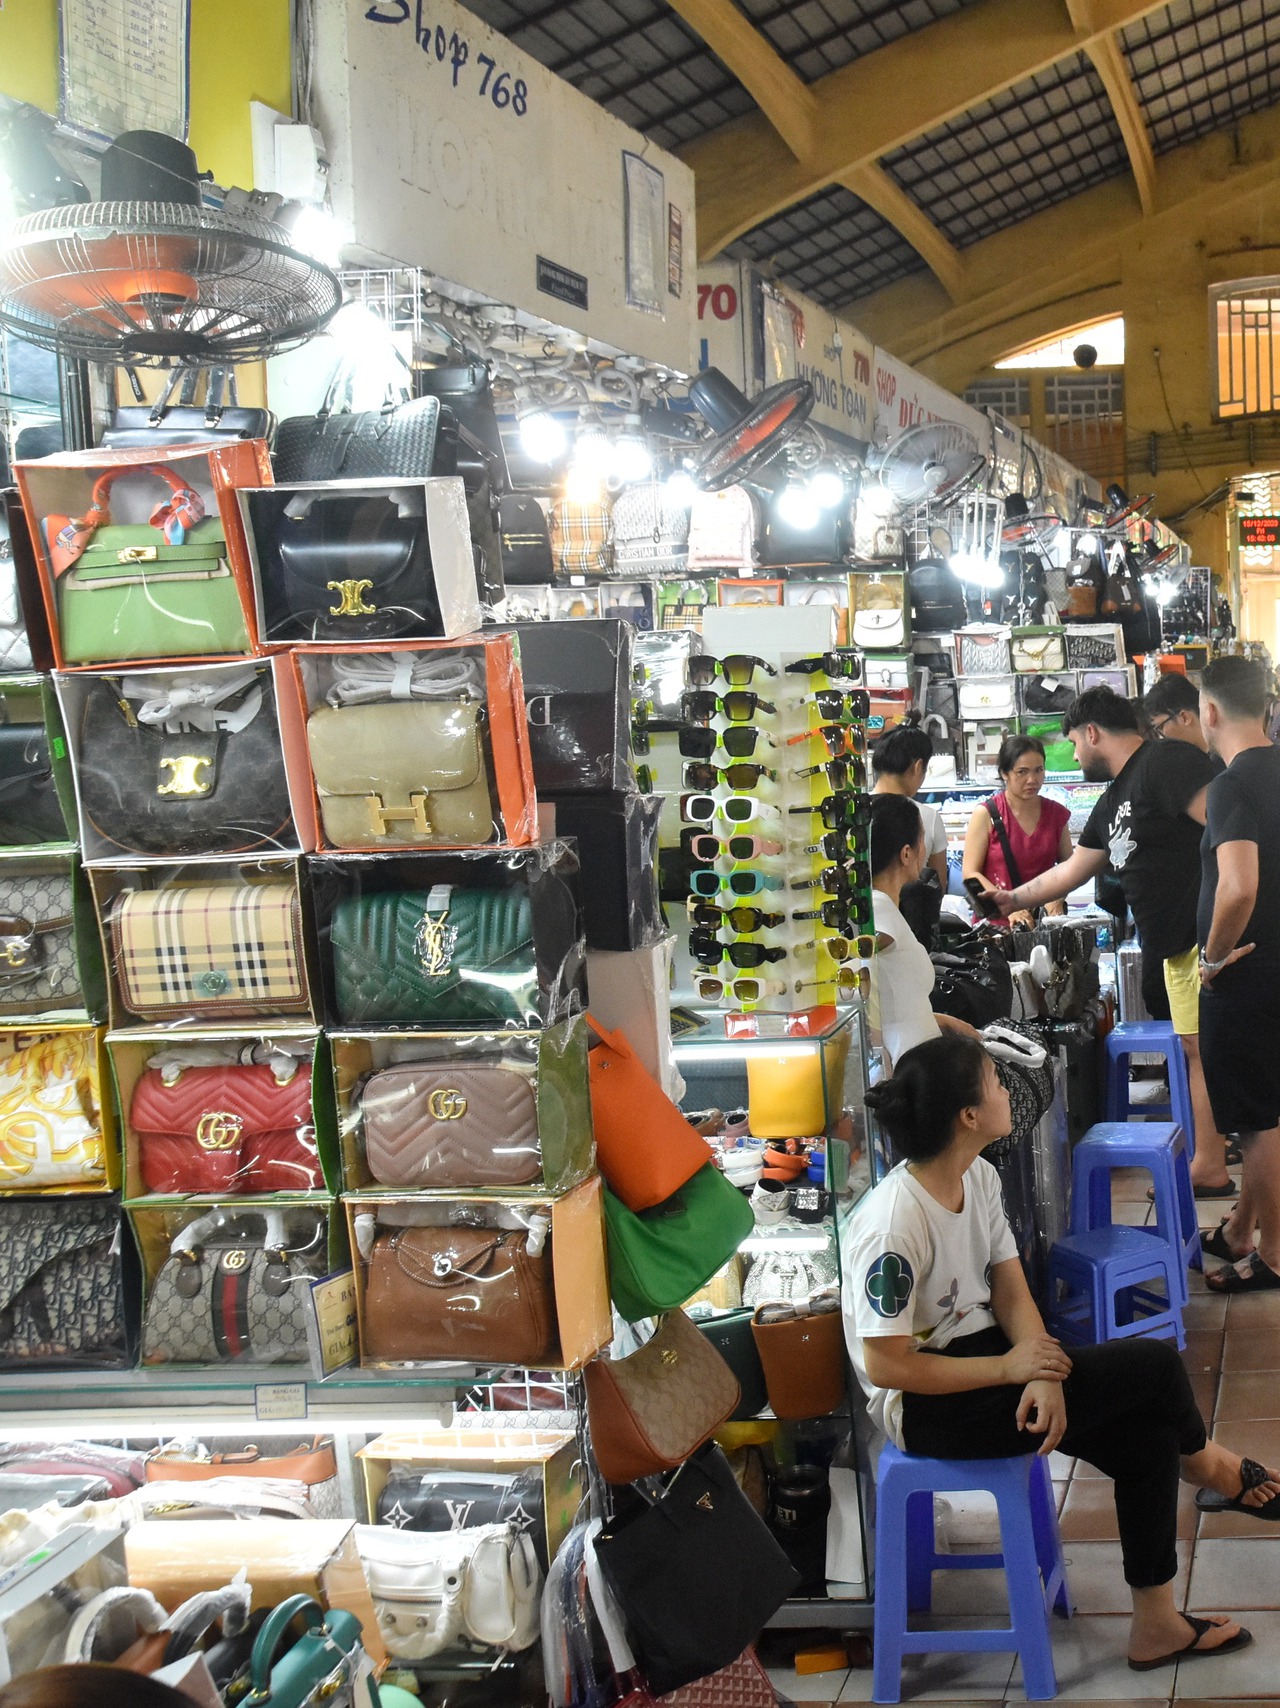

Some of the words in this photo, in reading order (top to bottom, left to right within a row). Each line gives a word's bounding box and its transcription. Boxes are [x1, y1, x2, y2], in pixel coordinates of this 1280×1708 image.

[365, 0, 468, 87] Shop
[477, 52, 527, 116] 768
[697, 284, 737, 320] 70
[877, 367, 896, 407] SHOP
